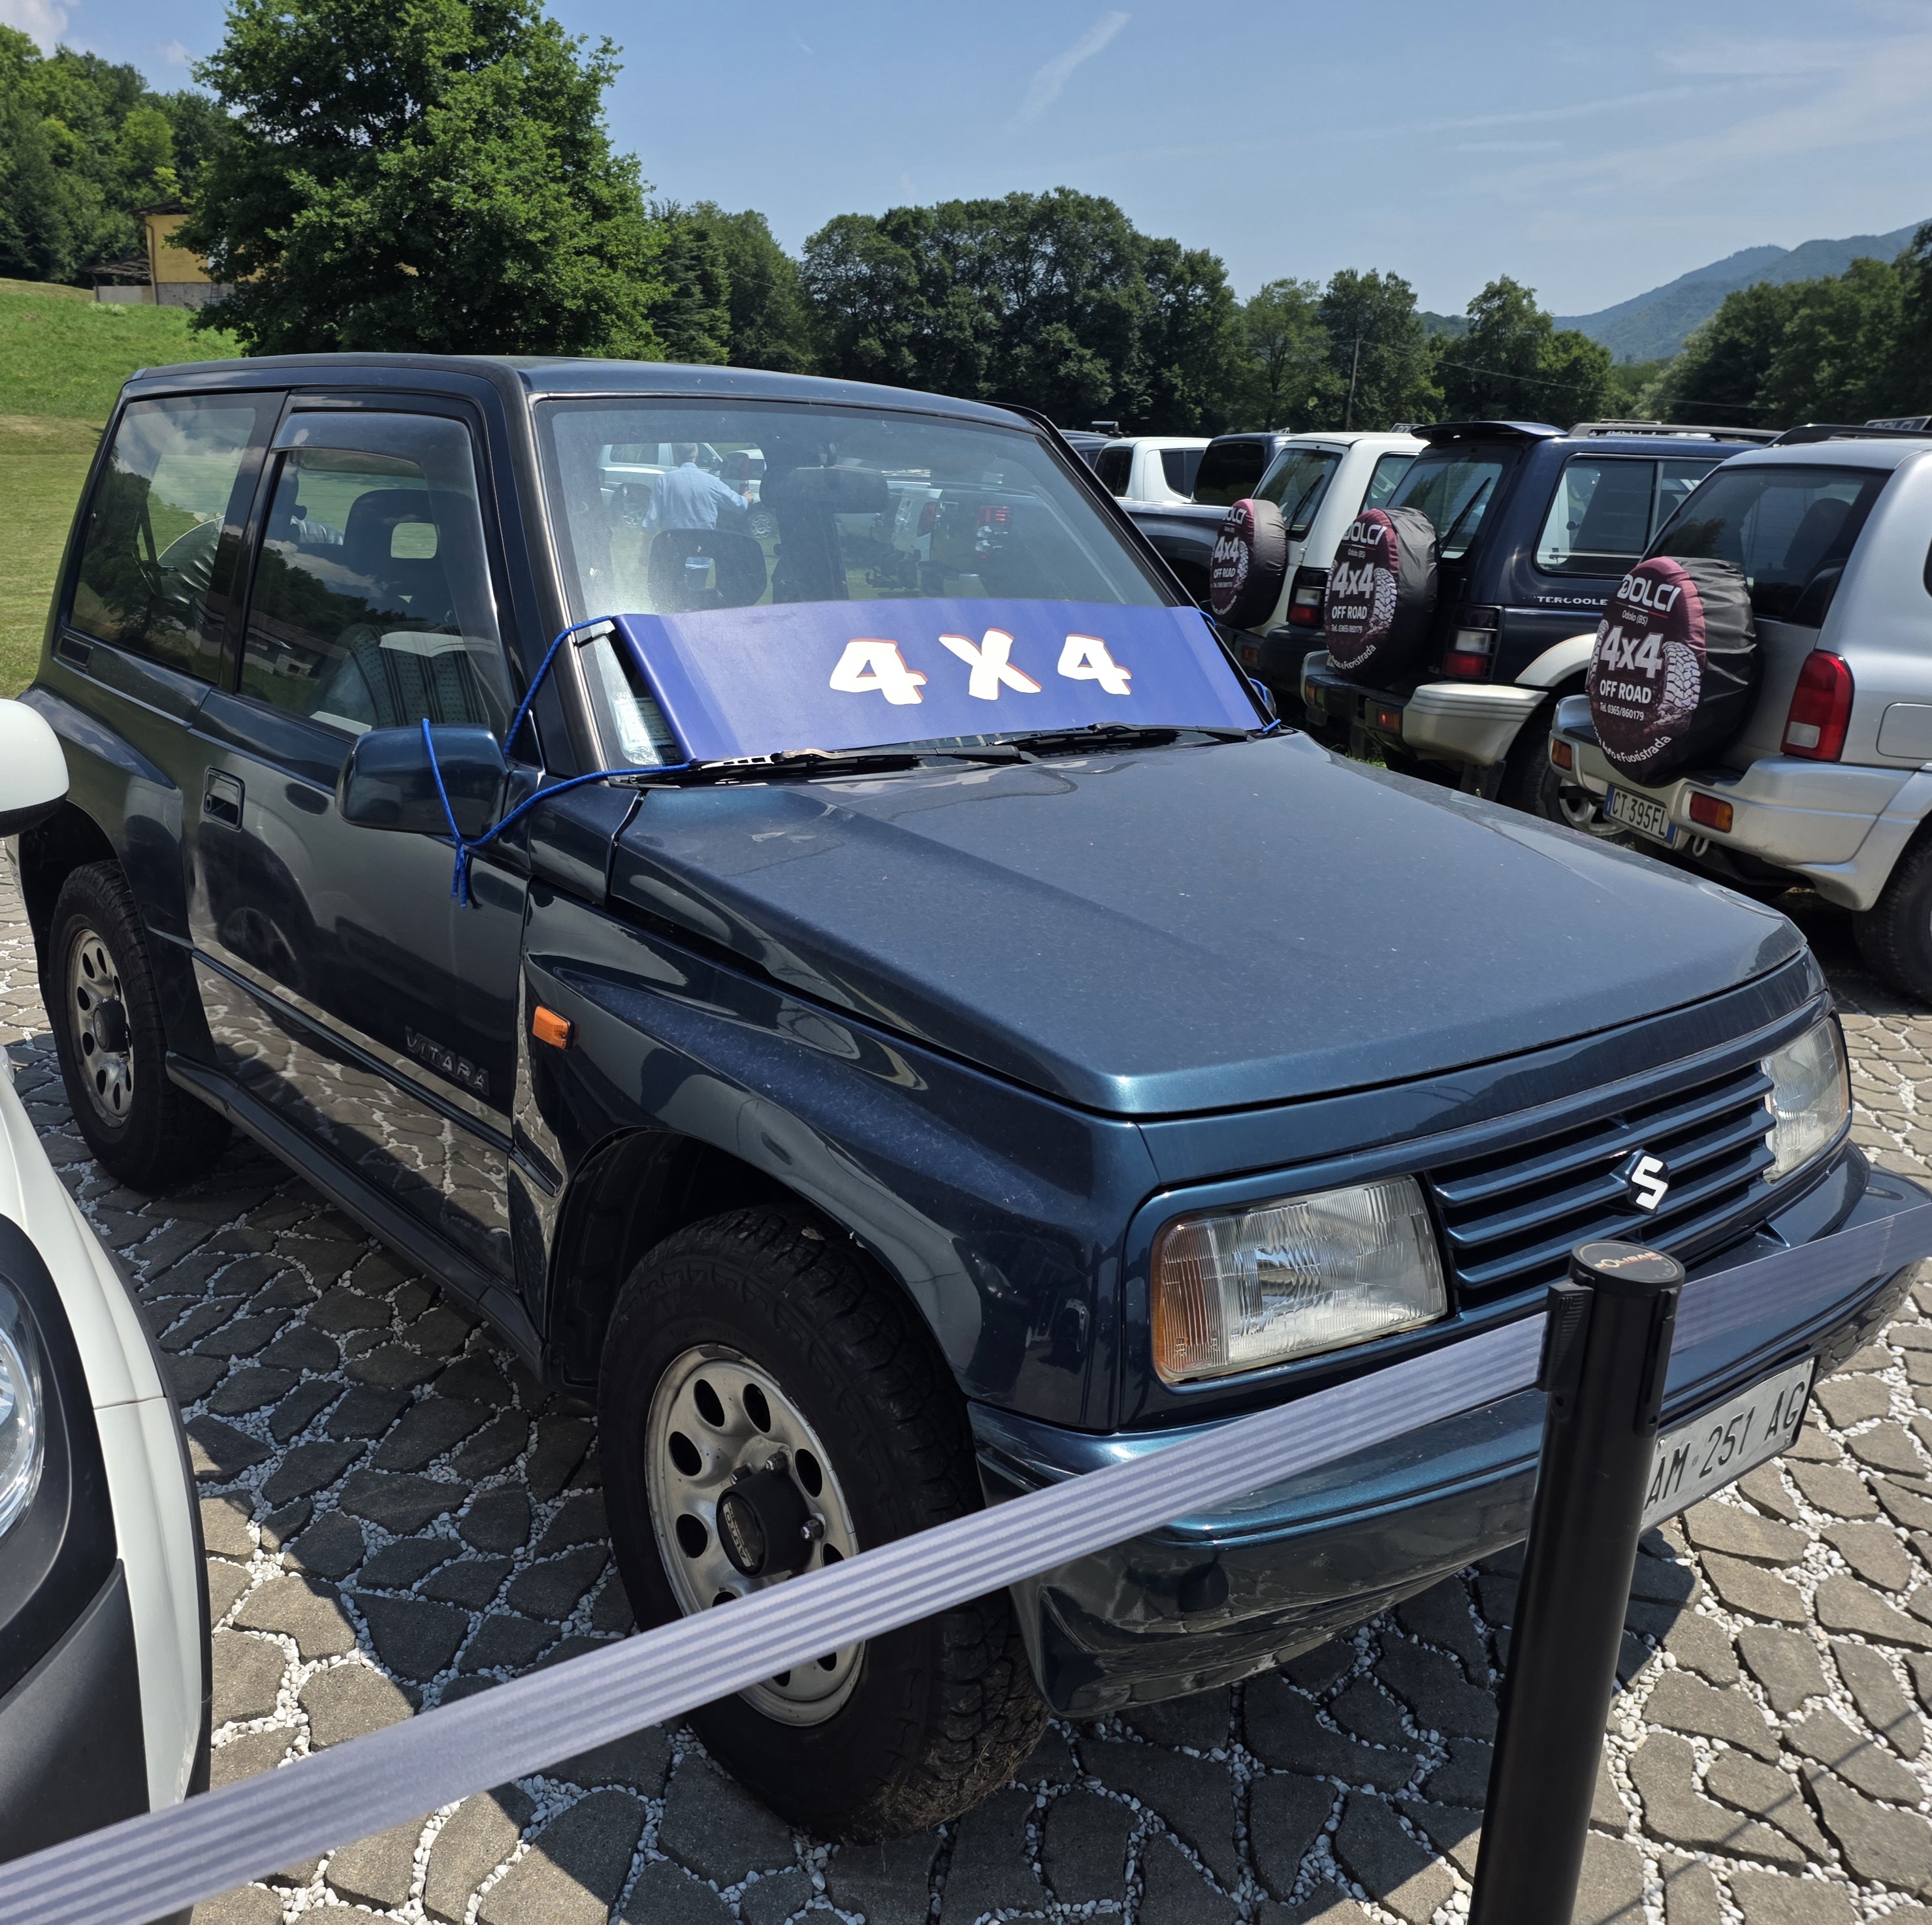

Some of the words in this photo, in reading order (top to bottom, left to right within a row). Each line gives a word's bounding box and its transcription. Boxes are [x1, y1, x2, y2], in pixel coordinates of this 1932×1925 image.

[1214, 536, 1239, 562] 4x4
[1332, 562, 1374, 599] 4x4
[1617, 574, 1681, 612] DOLCI
[1332, 606, 1347, 619] OFF
[1347, 606, 1367, 619] ROAD
[1622, 610, 1636, 622] Odolo
[1636, 616, 1649, 627] (BS)
[1600, 626, 1664, 679] 4x4
[1600, 680, 1617, 697] OFF
[1618, 682, 1652, 704] ROAD
[1607, 705, 1644, 721] 0365/860179
[1620, 736, 1672, 763] Fuoristrada
[1613, 791, 1628, 818] CT
[1629, 798, 1665, 836] 395FL
[406, 1026, 489, 1096] VITARA
[1644, 1440, 1692, 1510] AM
[1699, 1406, 1756, 1479] 251
[1764, 1380, 1806, 1441] AG
